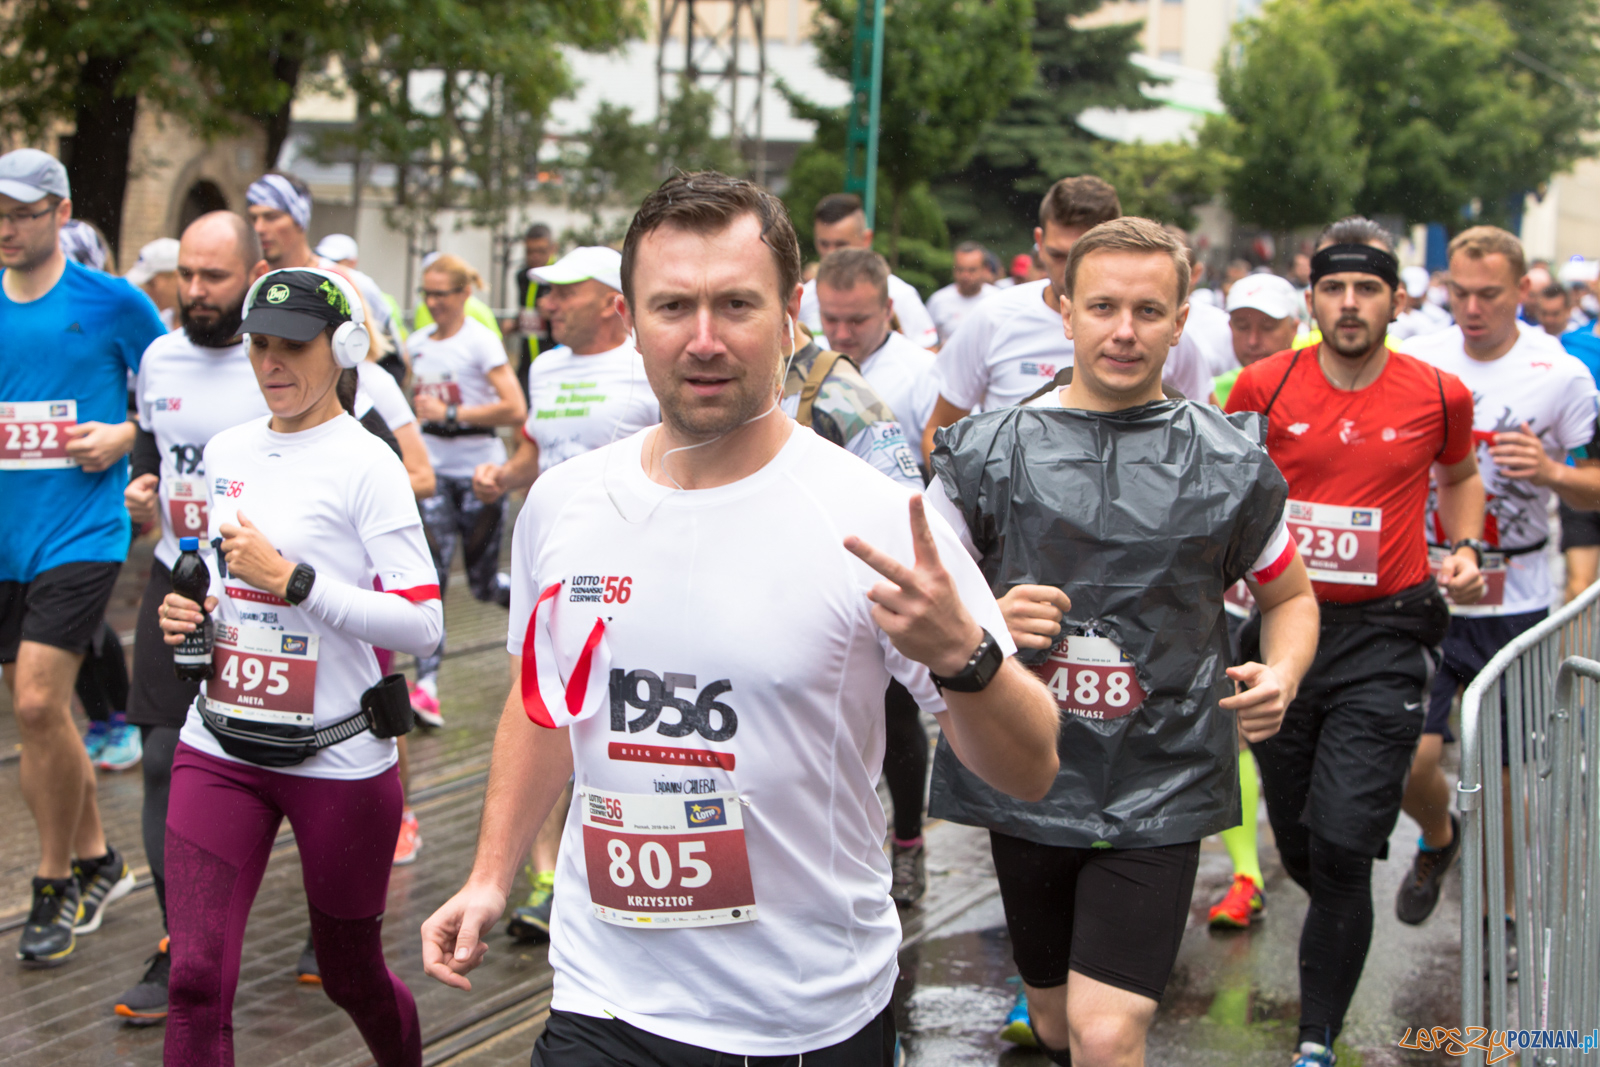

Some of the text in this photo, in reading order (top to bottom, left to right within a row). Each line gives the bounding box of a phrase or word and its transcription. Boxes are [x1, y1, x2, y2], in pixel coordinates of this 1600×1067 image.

[5, 423, 59, 450] 232
[1297, 527, 1359, 561] 230
[572, 576, 633, 604] LOTTO '56
[221, 654, 289, 695] 495
[1047, 666, 1130, 707] 488
[237, 694, 264, 706] ANETA
[608, 667, 738, 742] 1956
[621, 748, 651, 757] BIEG
[588, 793, 603, 804] LOTTO
[684, 779, 716, 794] CHLEBA
[695, 808, 716, 820] LOTTO
[607, 838, 712, 889] 805
[627, 895, 694, 907] KRZYSZTOF
